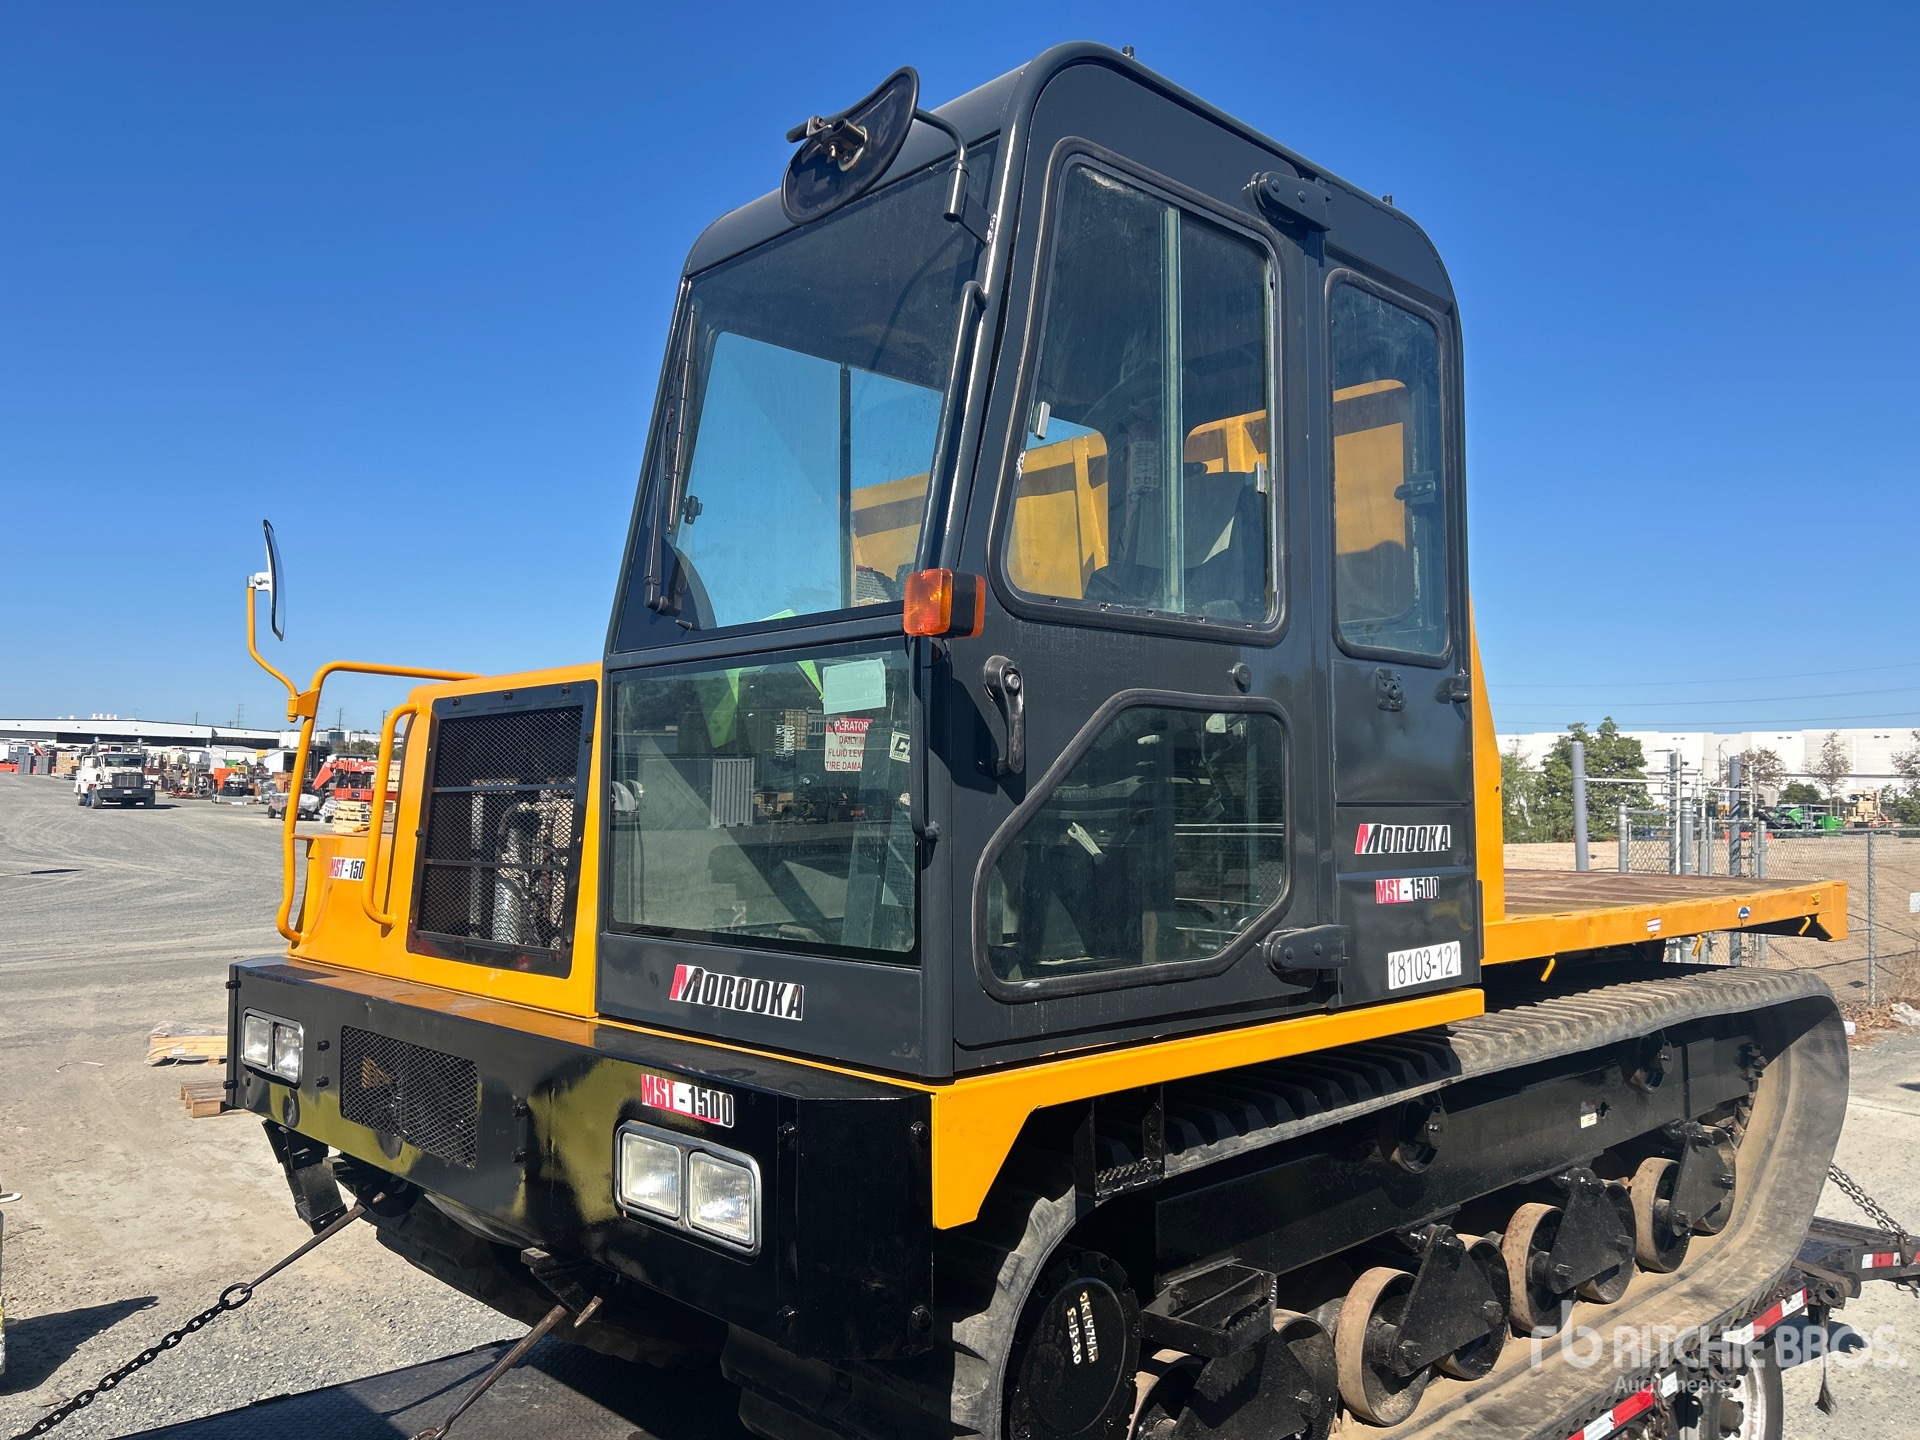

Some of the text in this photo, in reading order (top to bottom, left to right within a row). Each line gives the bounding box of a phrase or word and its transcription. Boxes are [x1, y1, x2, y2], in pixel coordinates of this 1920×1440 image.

[828, 748, 847, 757] FLUID
[839, 735, 857, 745] DAILY
[826, 761, 840, 770] TIRE
[1356, 824, 1449, 854] MOROOKA
[1376, 877, 1439, 904] MST-1500
[1390, 944, 1459, 987] 18103-121
[669, 964, 803, 1020] MOROOKA
[641, 1073, 733, 1127] MST-1500
